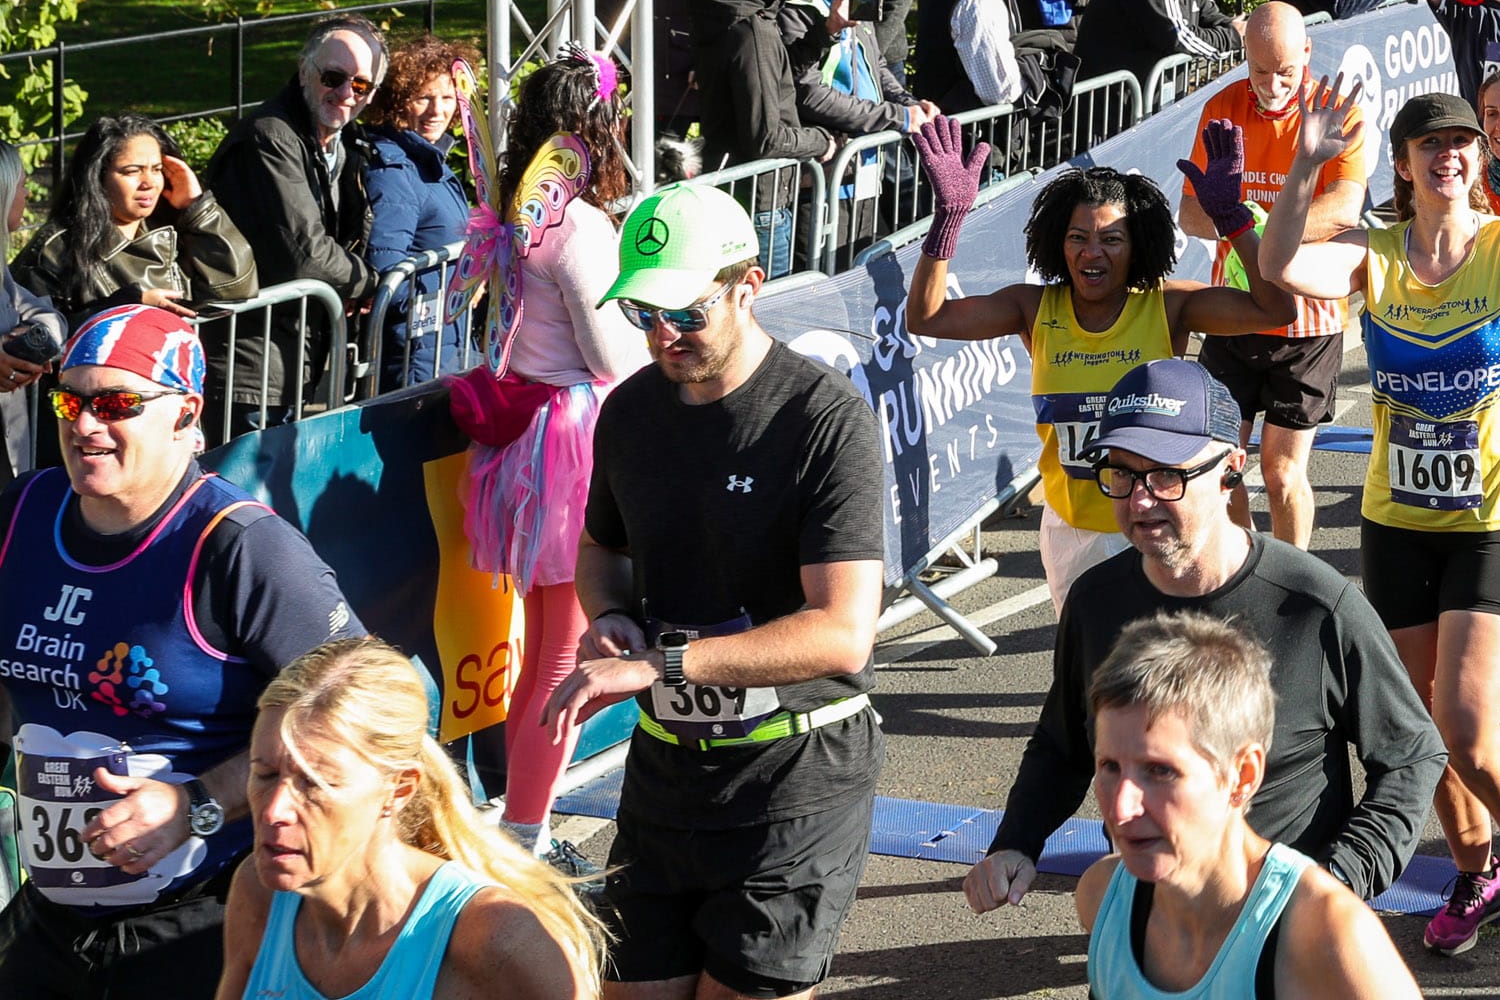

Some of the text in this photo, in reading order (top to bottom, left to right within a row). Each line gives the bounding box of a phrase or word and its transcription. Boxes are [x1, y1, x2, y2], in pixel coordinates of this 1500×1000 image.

[1385, 22, 1451, 79] GOOD
[1073, 350, 1121, 362] WERRINGTON
[880, 334, 1017, 463] RUNNING
[1086, 396, 1107, 404] GREAT
[1108, 393, 1188, 413] Quiksilver
[1415, 422, 1436, 432] GREAT
[1423, 438, 1438, 448] RUN
[890, 413, 998, 525] EVENTS
[1397, 449, 1475, 492] 1609
[43, 584, 93, 626] JC
[16, 623, 85, 661] Brain
[53, 687, 88, 712] UK
[44, 762, 70, 773] GREAT
[37, 772, 71, 786] EASTERN
